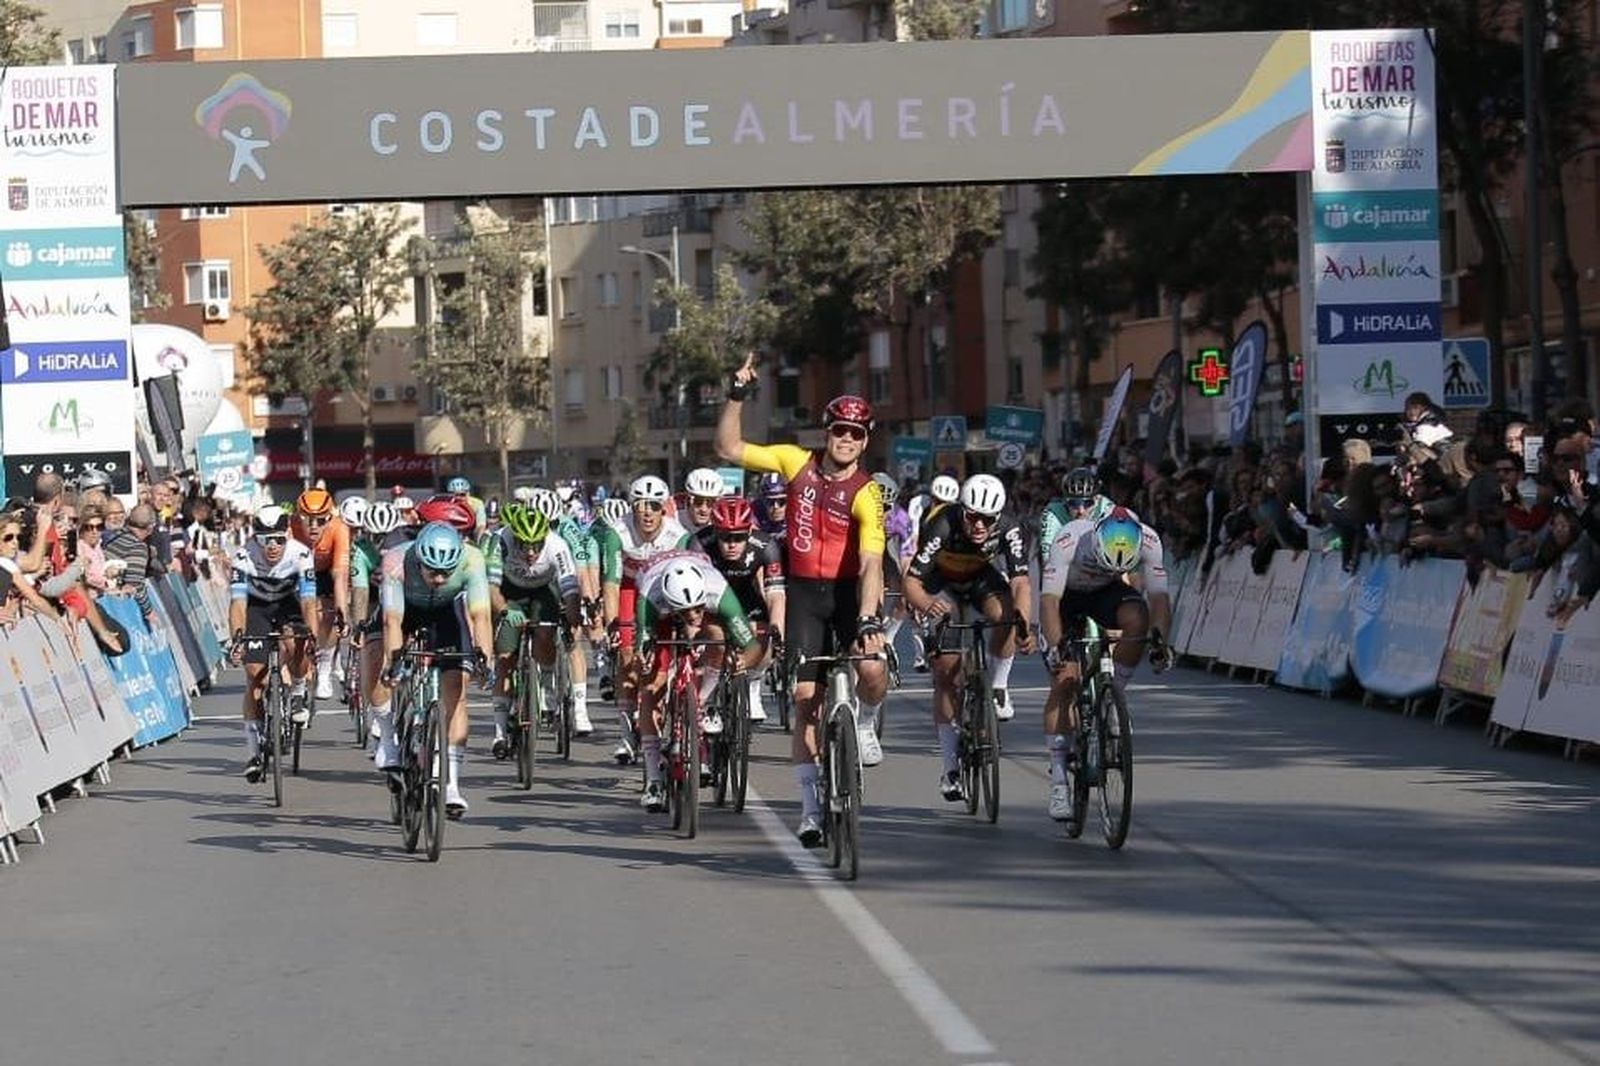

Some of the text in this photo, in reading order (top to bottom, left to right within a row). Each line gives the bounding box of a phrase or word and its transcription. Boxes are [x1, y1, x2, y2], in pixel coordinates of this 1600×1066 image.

[1331, 41, 1415, 62] ROQUETAS
[11, 76, 98, 99] ROQUETAS
[1322, 89, 1415, 110] turismo
[4, 125, 96, 148] turismo
[1353, 205, 1431, 229] cajamar
[38, 242, 116, 267] cajamar
[20, 462, 117, 475] VOLVO
[793, 486, 816, 552] Cofidis
